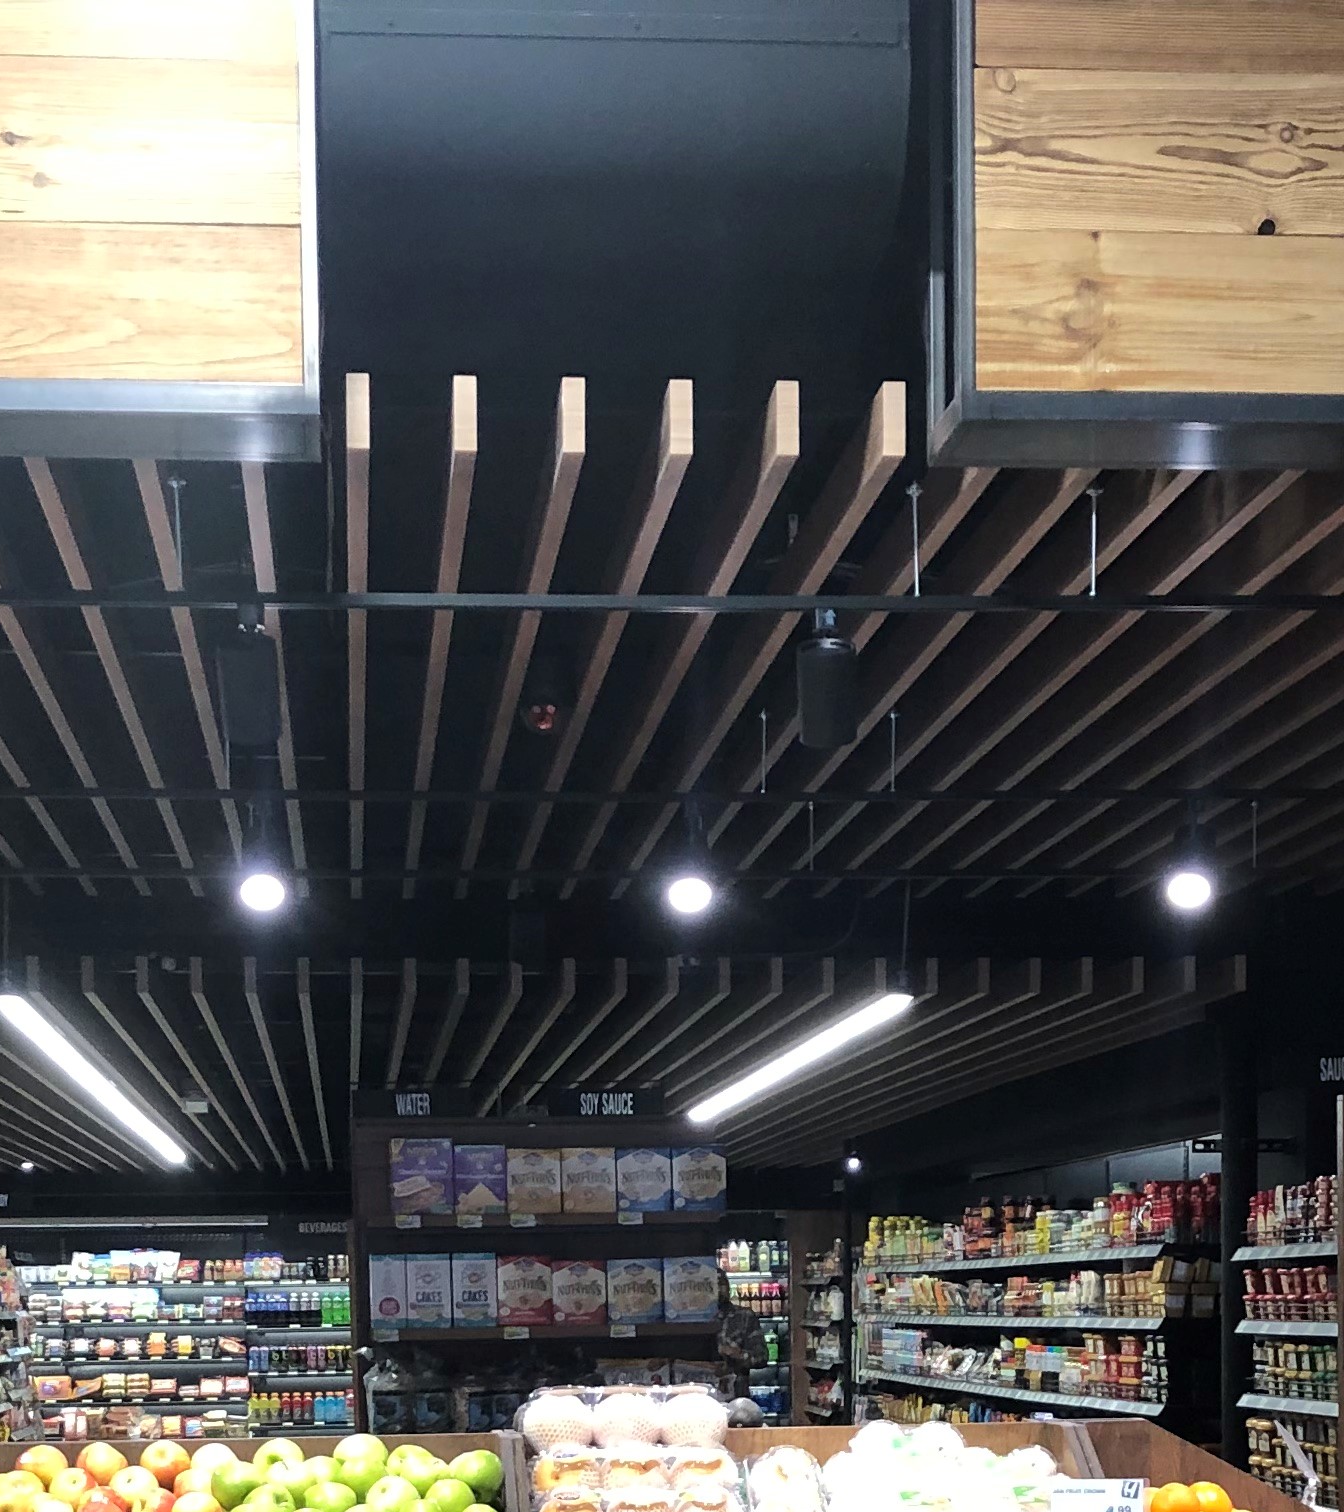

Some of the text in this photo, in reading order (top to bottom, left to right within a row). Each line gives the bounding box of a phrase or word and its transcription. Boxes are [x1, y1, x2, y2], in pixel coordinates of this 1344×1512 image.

[395, 1093, 430, 1115] WATER
[580, 1092, 634, 1115] SOY SAUCE
[298, 1221, 348, 1234] BEVERAGES
